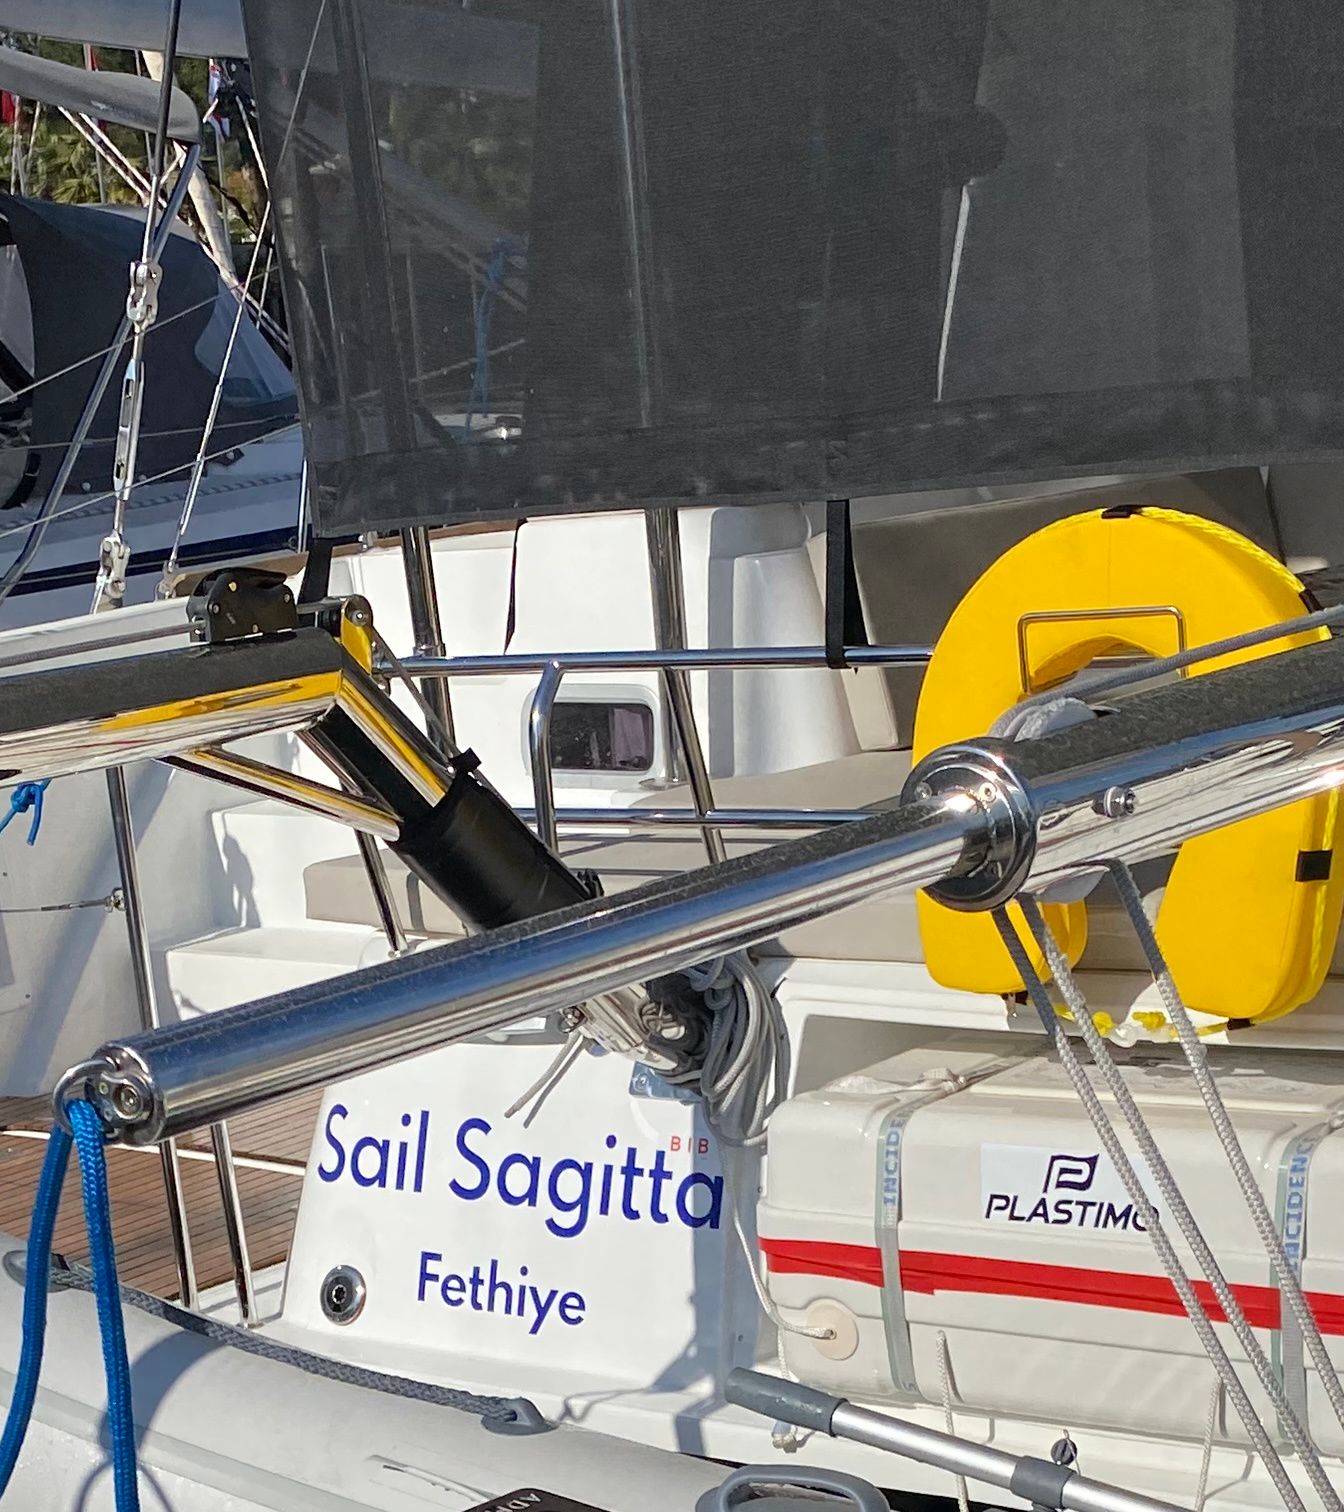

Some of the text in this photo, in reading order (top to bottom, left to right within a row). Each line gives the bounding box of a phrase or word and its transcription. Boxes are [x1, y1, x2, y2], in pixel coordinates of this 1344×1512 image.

[318, 1103, 725, 1239] Sail Sagitta
[417, 1250, 587, 1335] Fethiye
